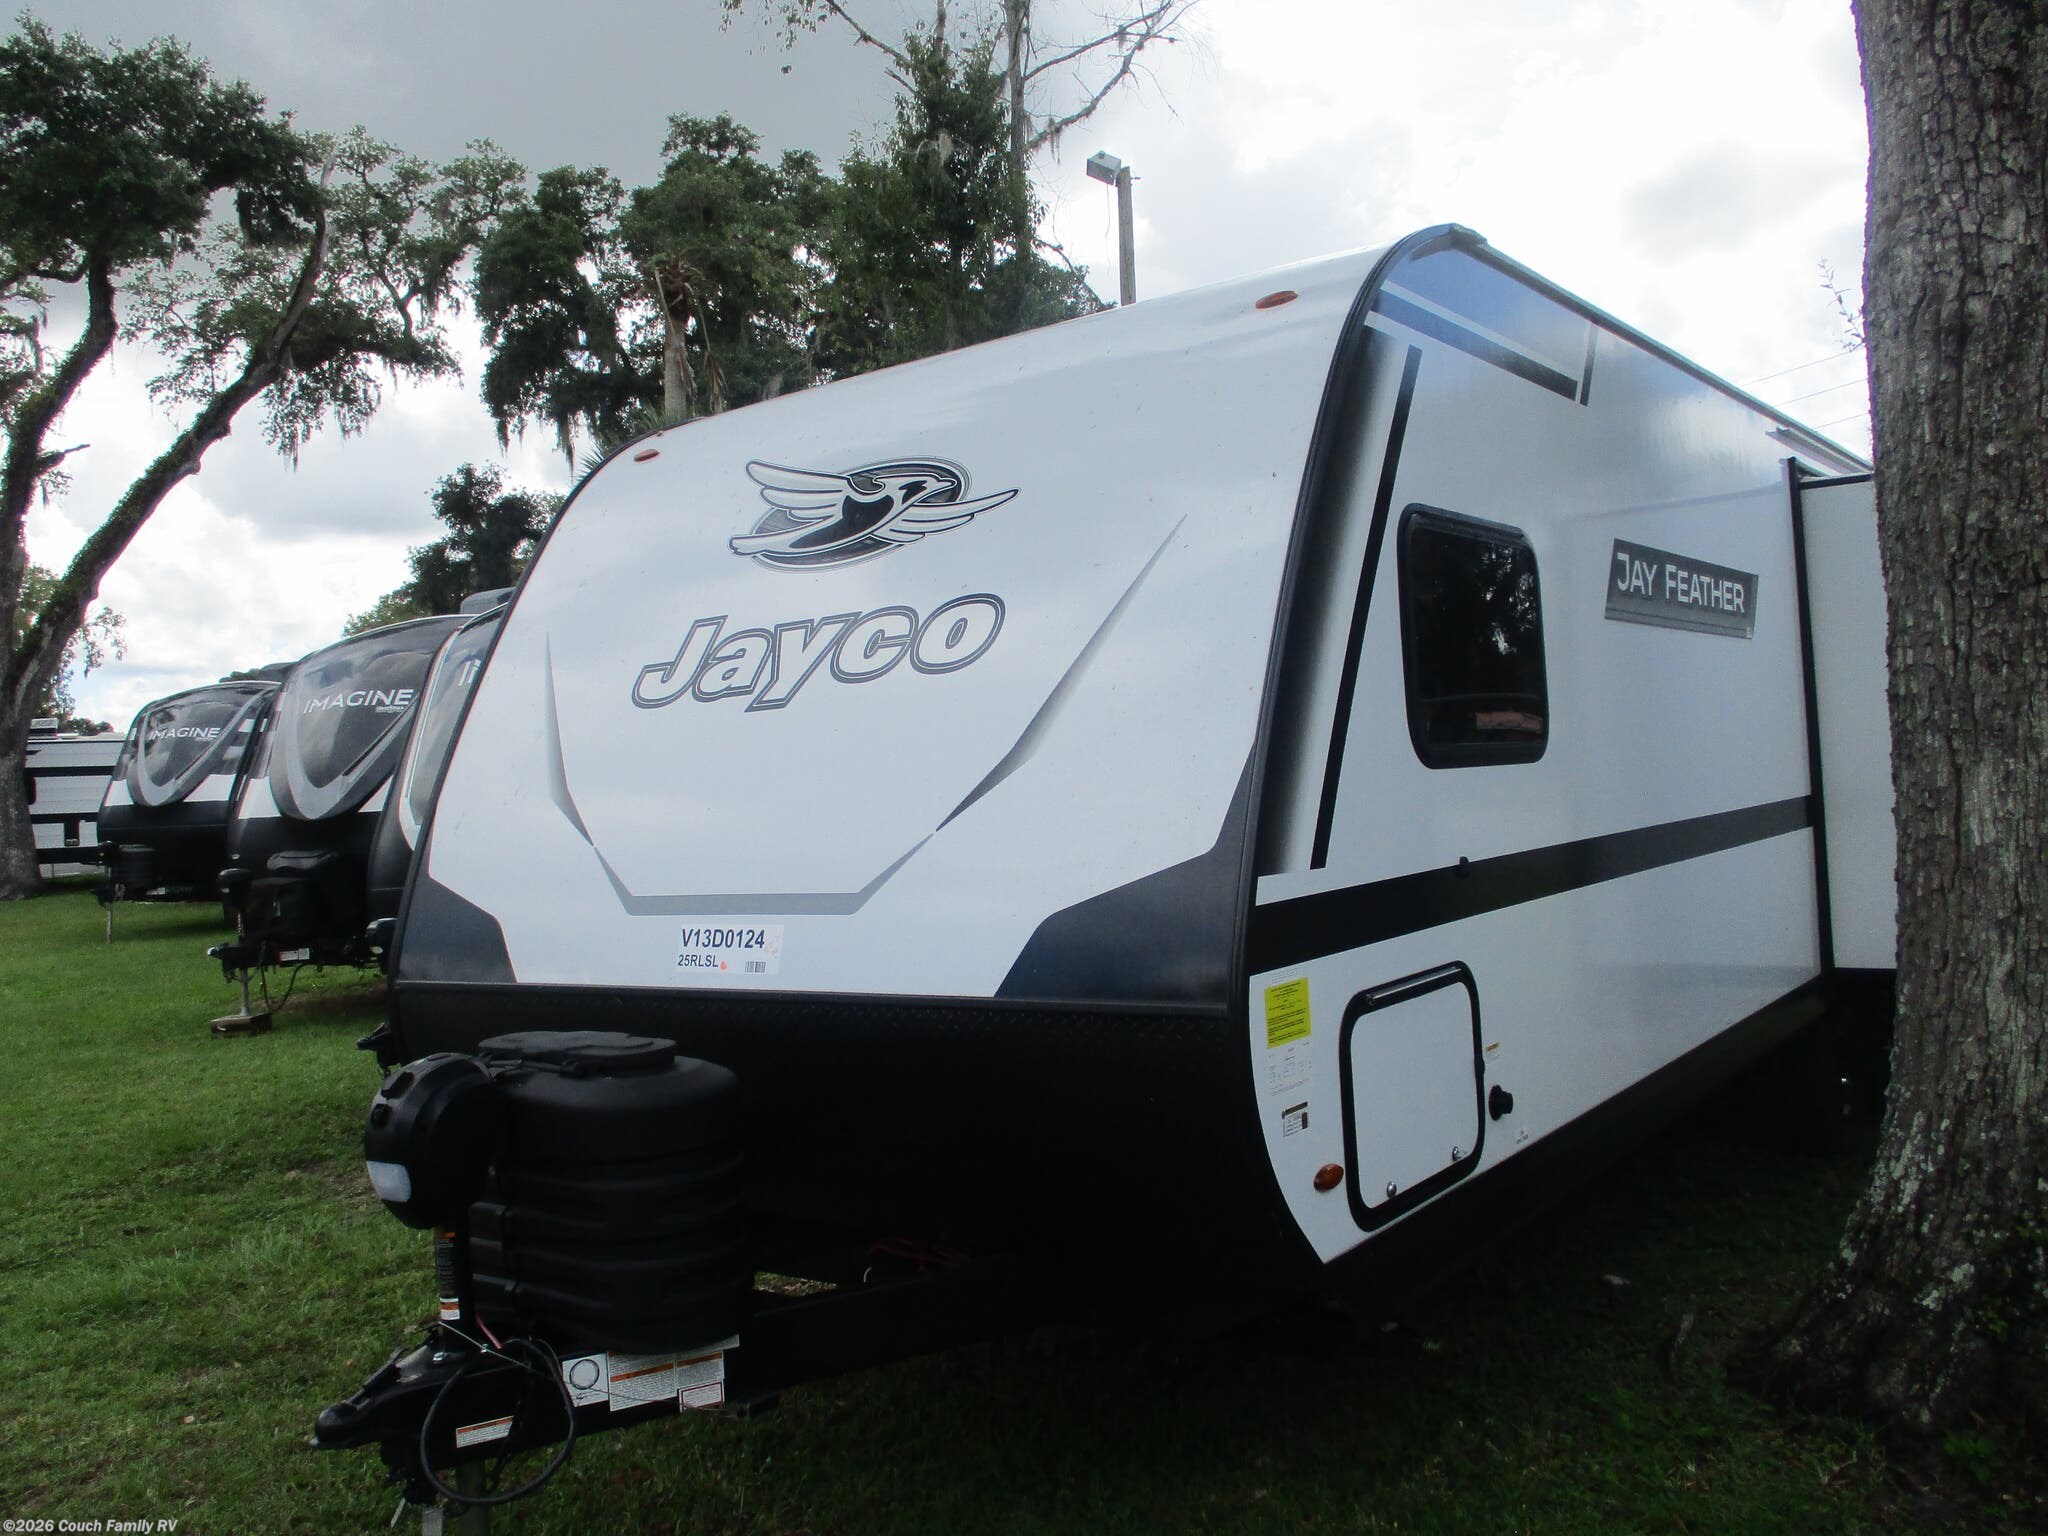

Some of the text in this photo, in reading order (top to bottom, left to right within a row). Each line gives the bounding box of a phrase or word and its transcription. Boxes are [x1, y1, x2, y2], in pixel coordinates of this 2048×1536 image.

[1617, 552, 1745, 613] JAY FEATHER
[631, 592, 1006, 713] Jayco
[303, 688, 414, 714] IMAGINE
[149, 727, 221, 740] IMAGINE
[682, 928, 766, 949] V13D0124
[677, 954, 719, 968] 25RLSL
